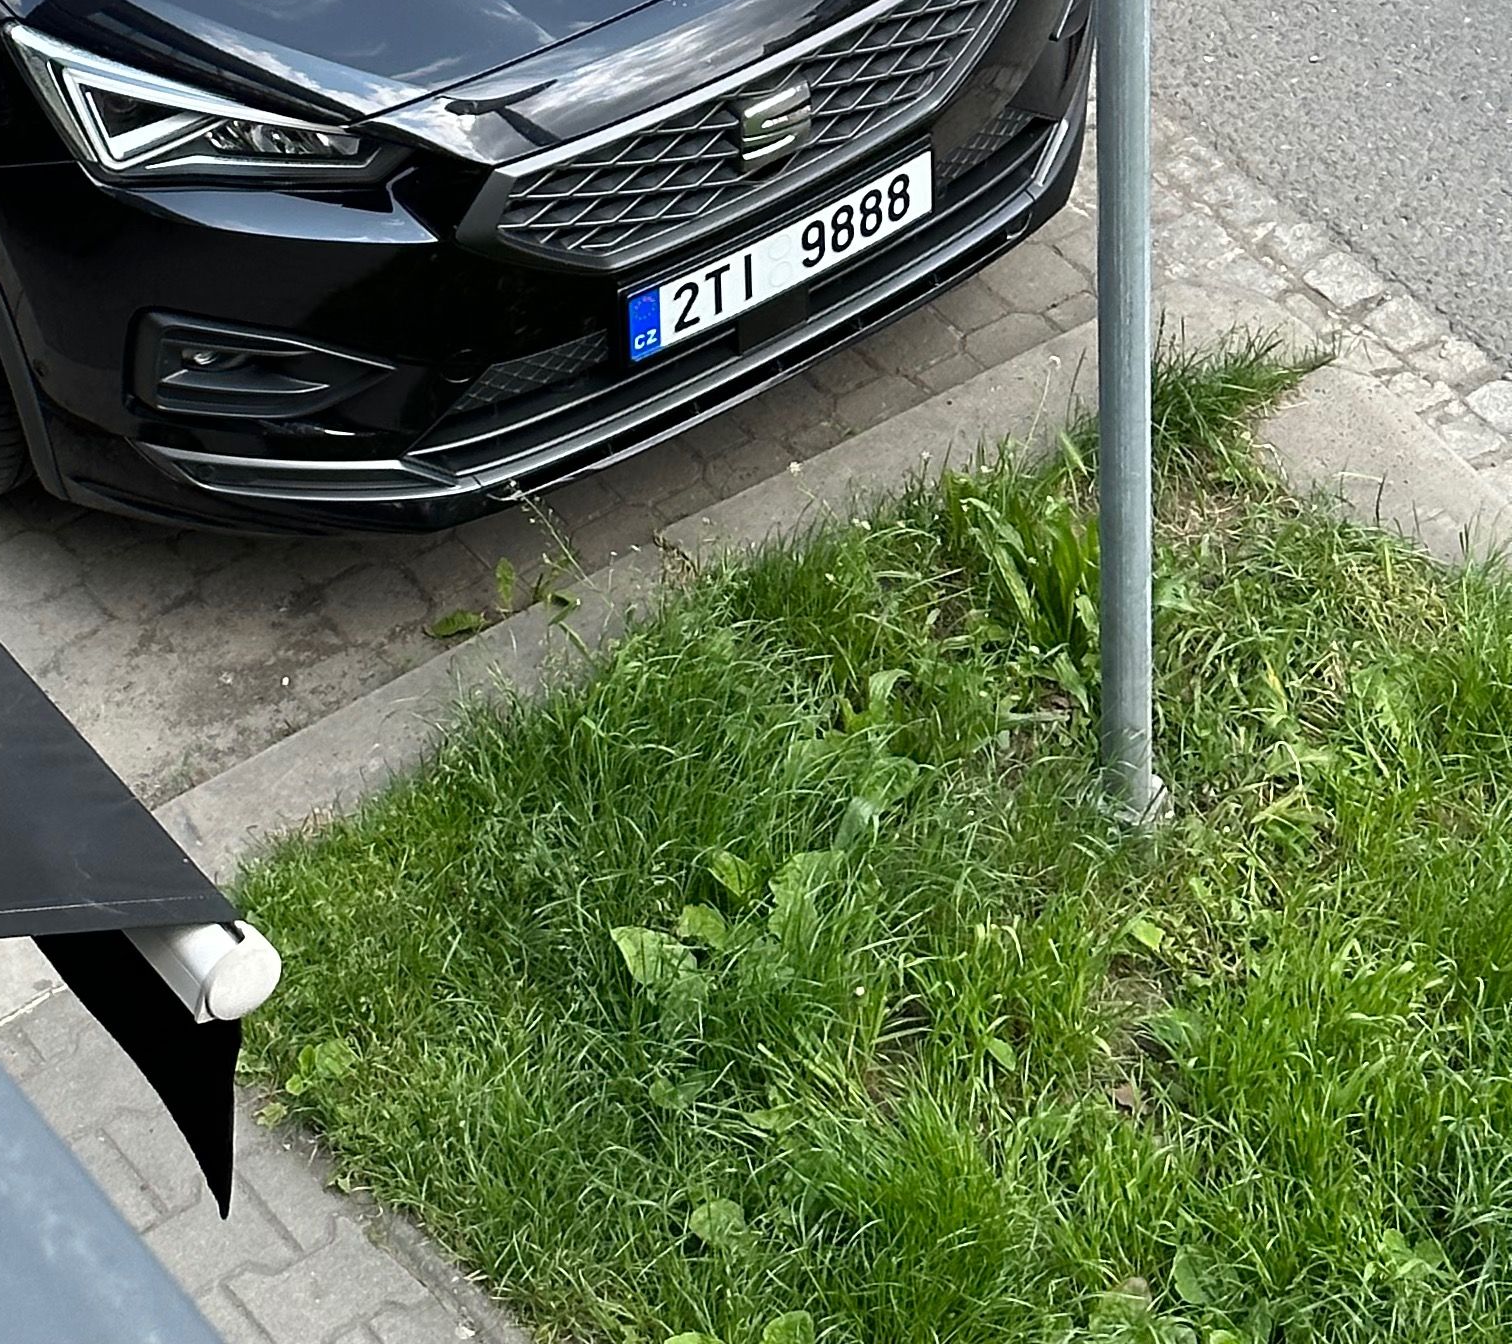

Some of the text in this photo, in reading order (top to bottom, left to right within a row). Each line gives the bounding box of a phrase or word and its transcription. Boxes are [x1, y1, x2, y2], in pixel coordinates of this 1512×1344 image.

[673, 173, 911, 333] 2TI 9888
[634, 328, 658, 350] CZ
